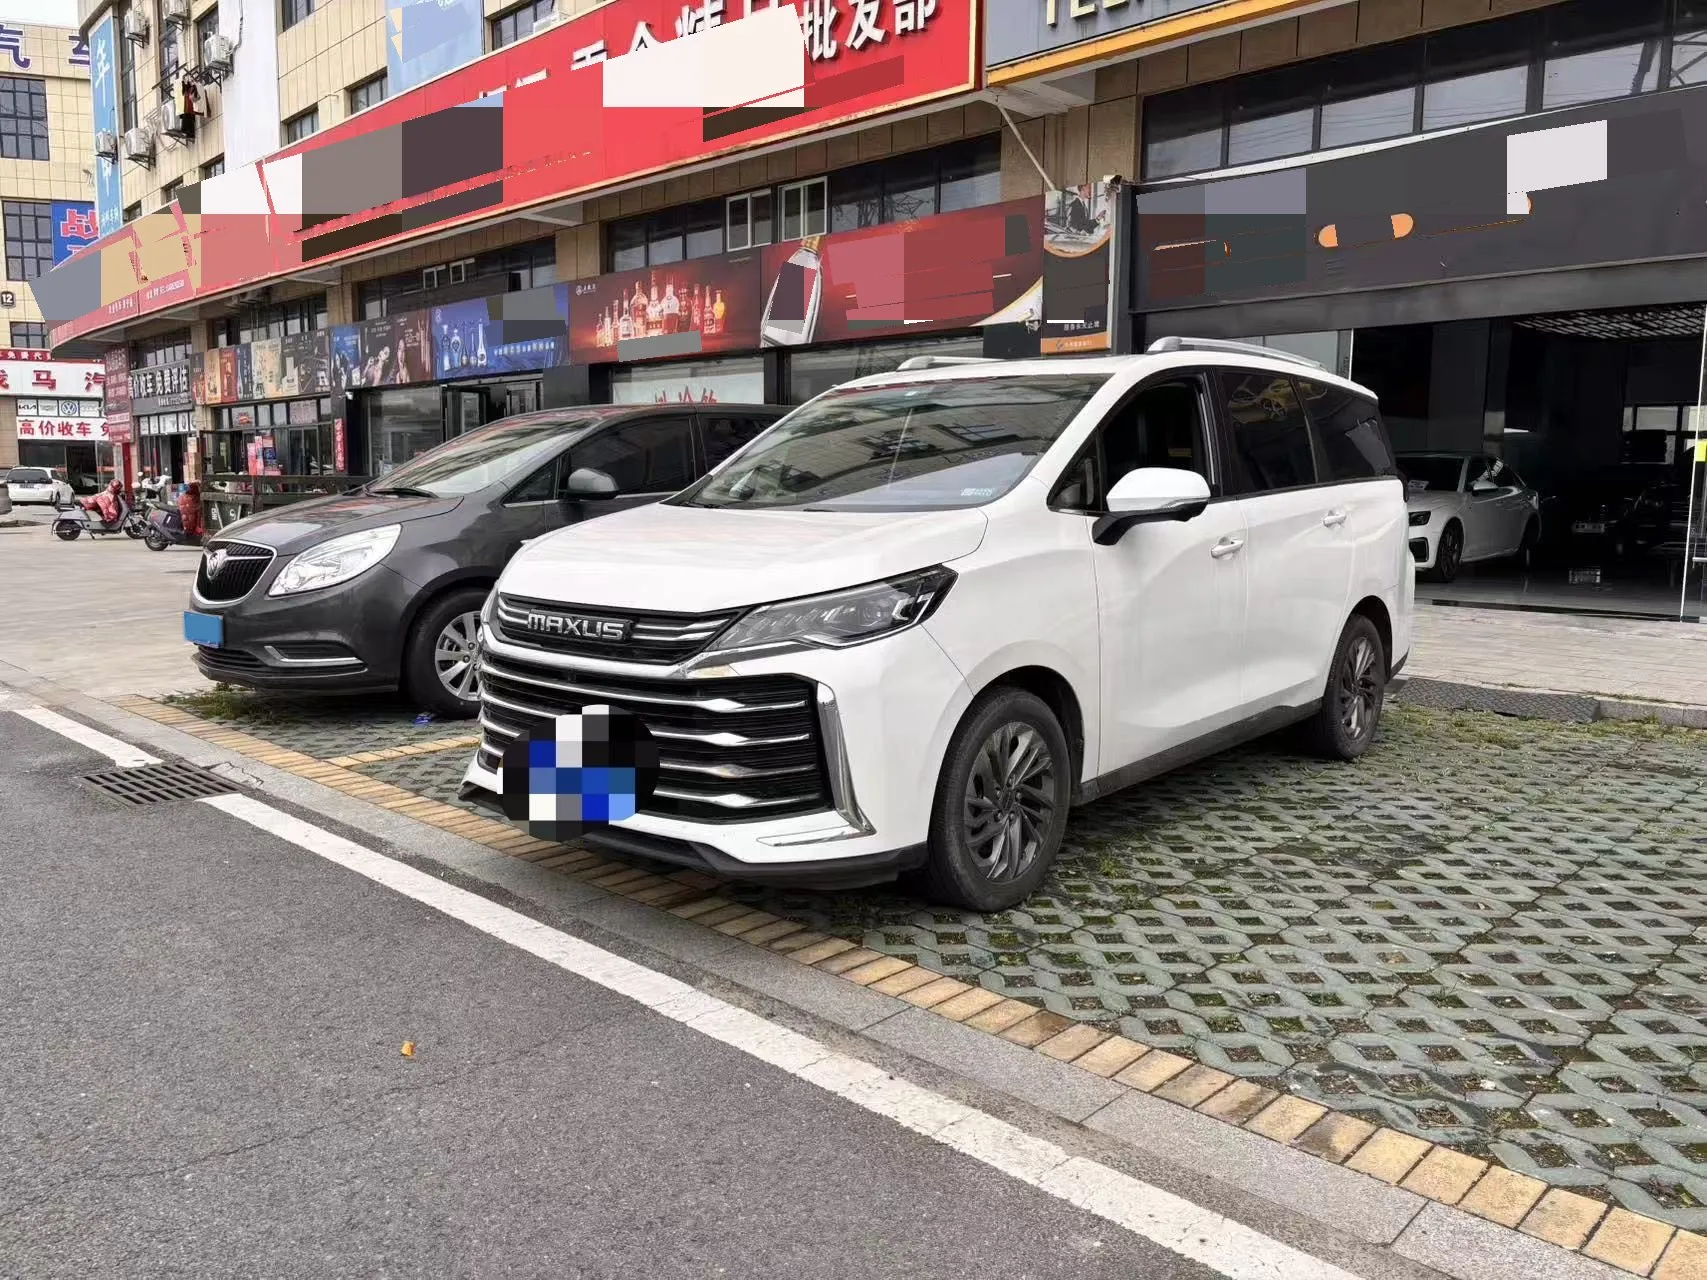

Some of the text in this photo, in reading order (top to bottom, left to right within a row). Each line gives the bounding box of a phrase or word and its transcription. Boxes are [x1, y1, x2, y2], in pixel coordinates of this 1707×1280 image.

[2, 293, 13, 303] 12
[18, 419, 92, 437] 高价收车
[527, 613, 624, 640] MAXUS
